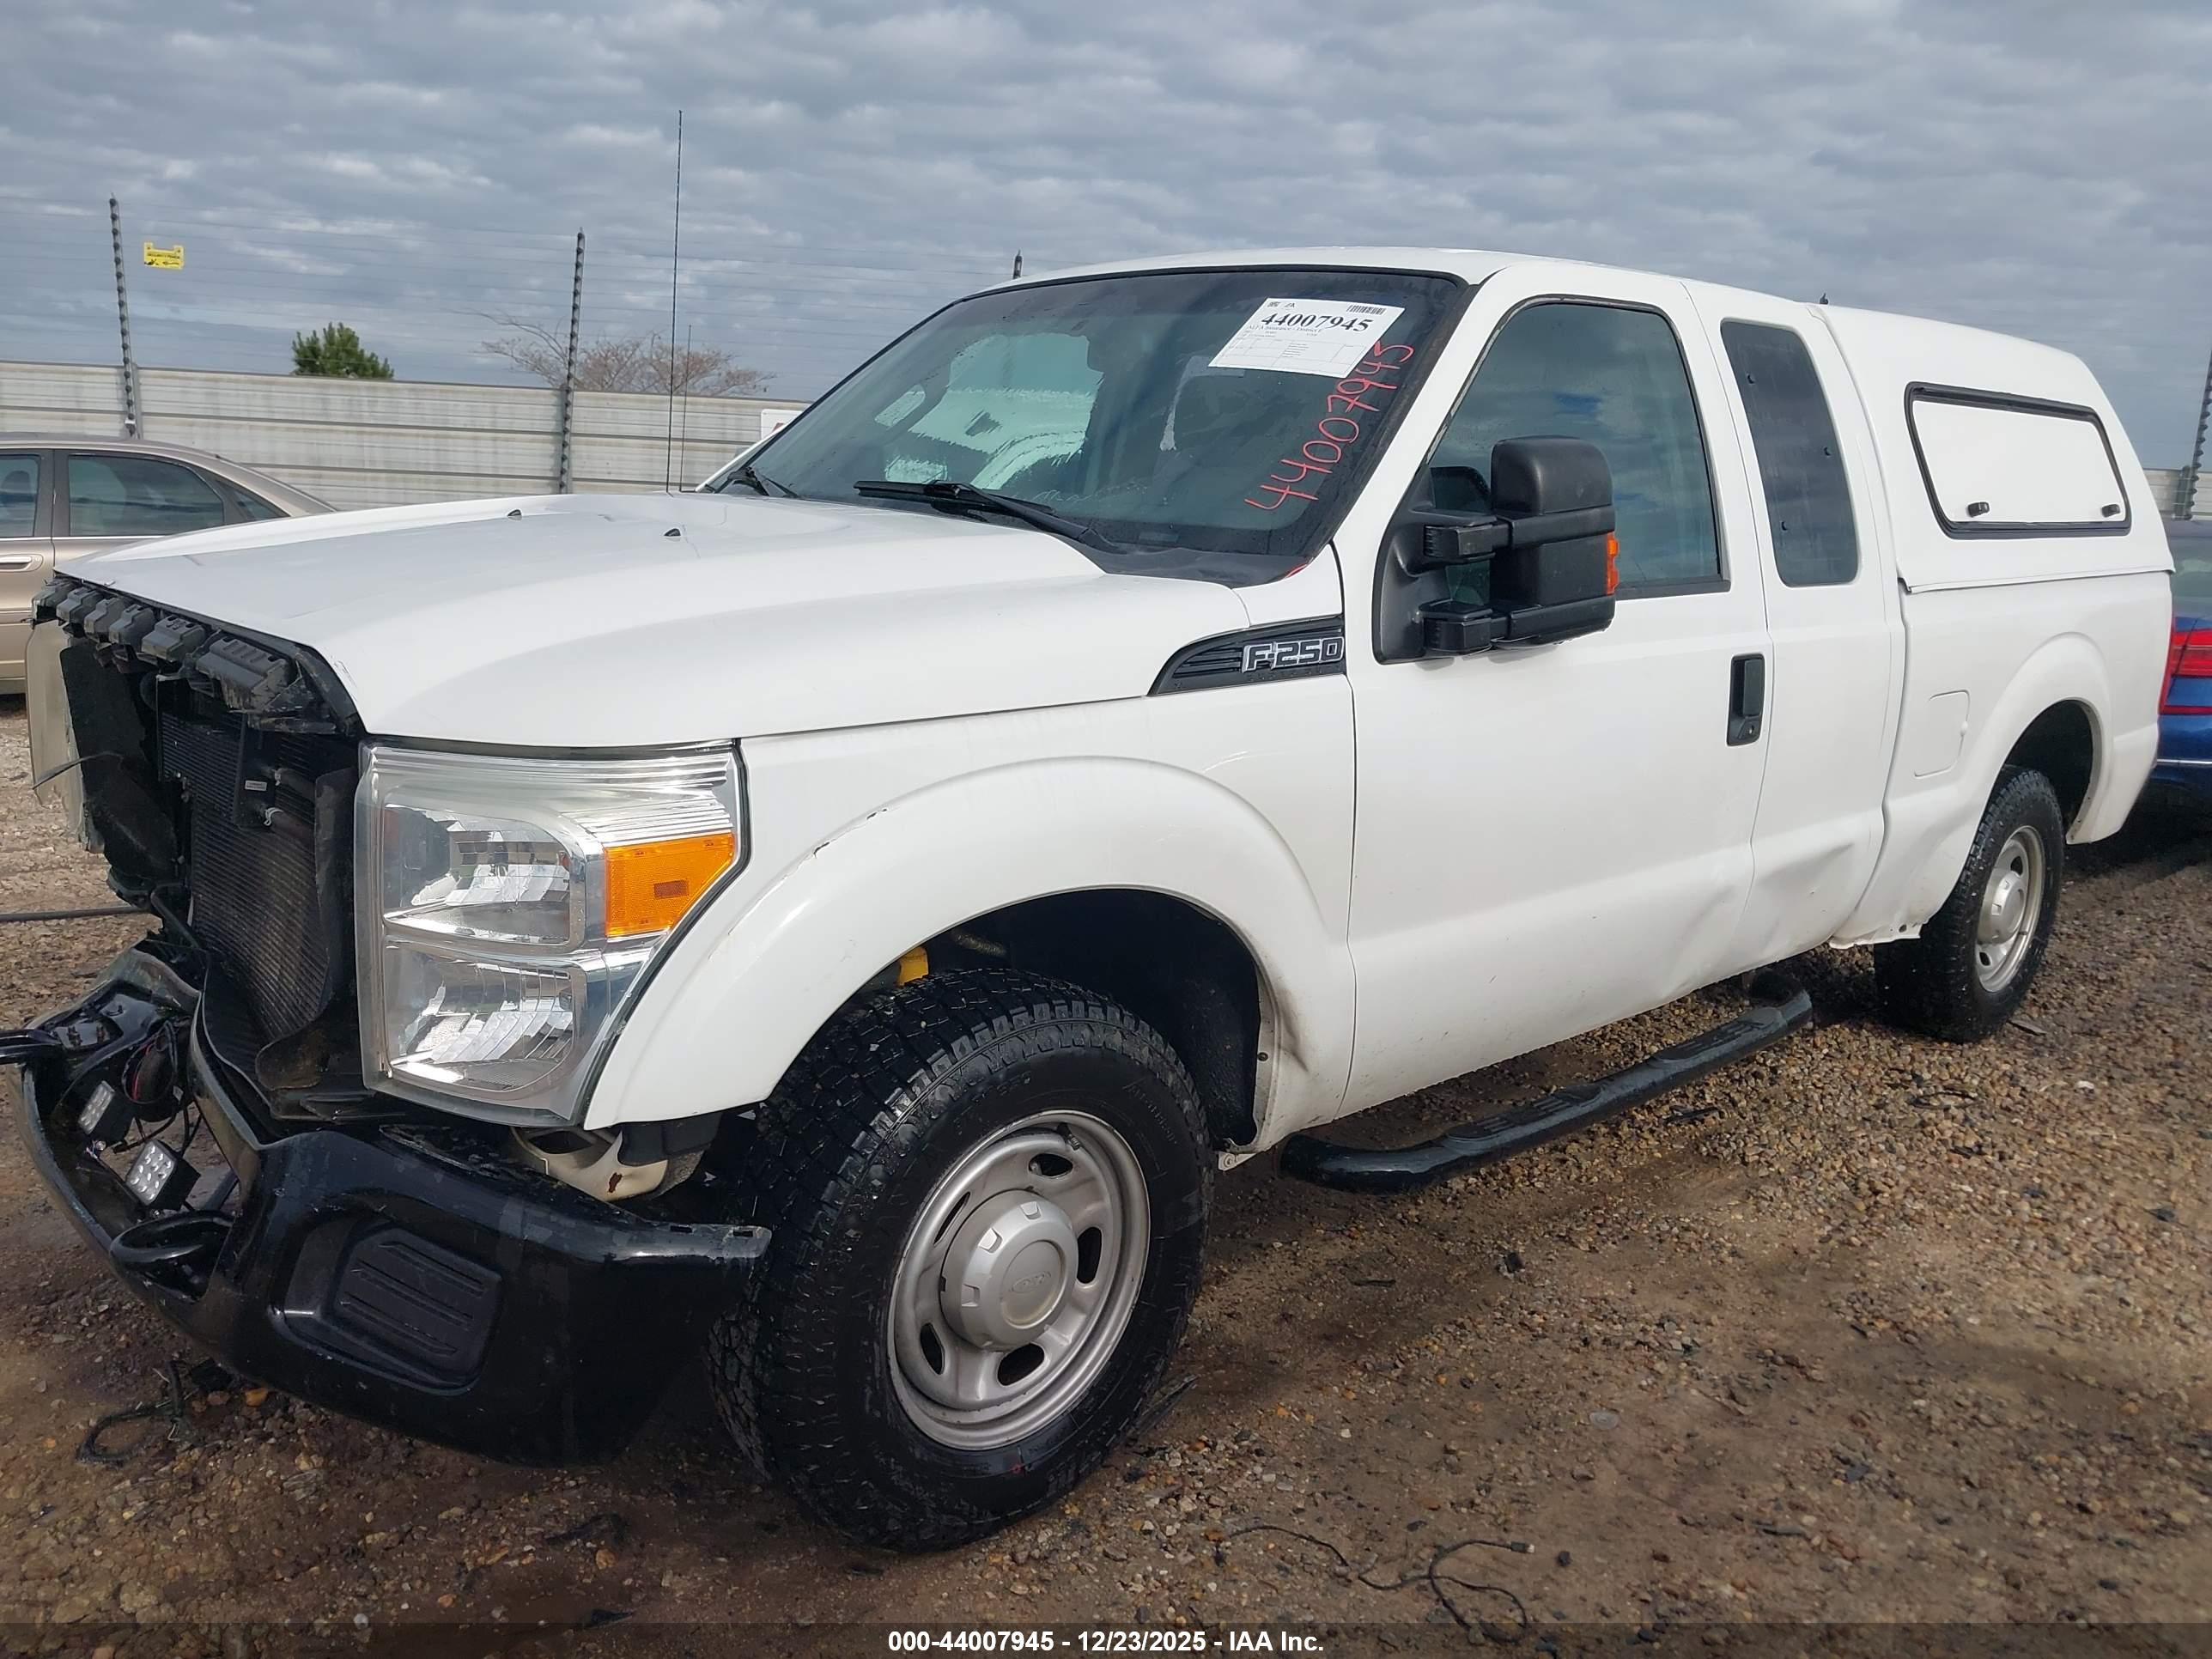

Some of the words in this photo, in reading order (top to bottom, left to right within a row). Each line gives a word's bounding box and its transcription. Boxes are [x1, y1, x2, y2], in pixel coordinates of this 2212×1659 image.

[1261, 313, 1373, 332] 44007945
[1244, 340, 1415, 510] 44007945
[1242, 636, 1345, 673] F-250
